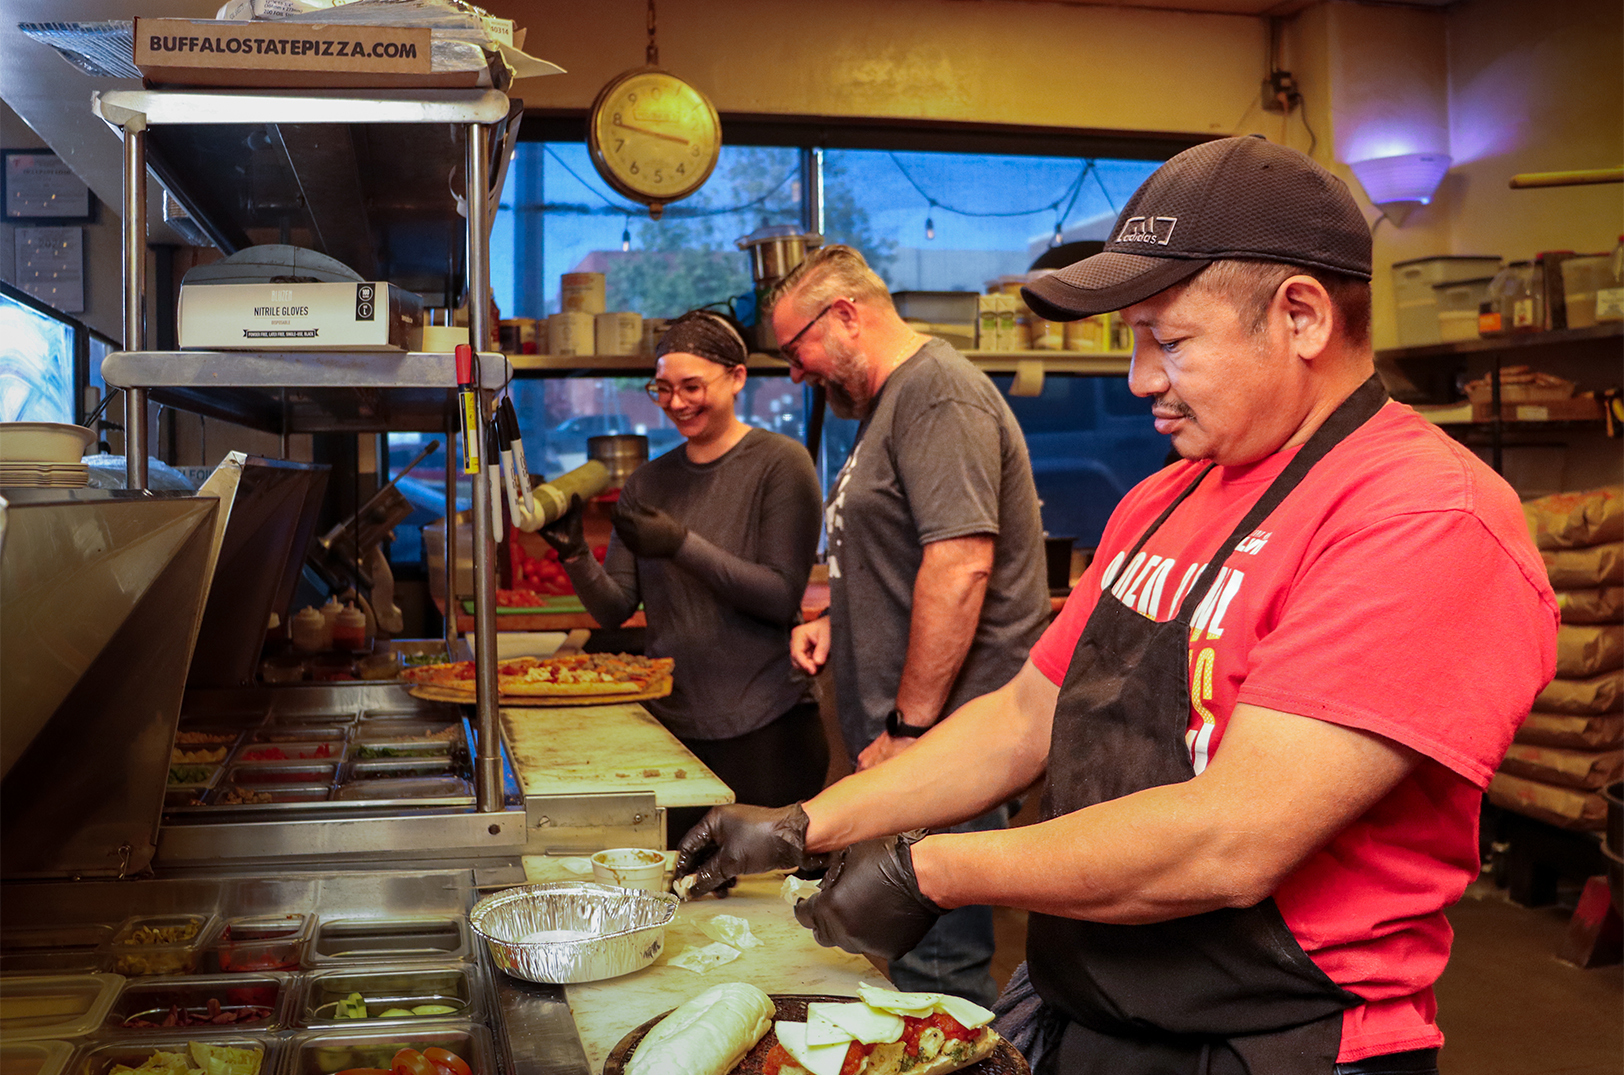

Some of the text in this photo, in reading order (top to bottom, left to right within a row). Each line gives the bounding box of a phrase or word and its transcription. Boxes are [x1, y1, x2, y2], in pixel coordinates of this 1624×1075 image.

[150, 36, 417, 58] BUFFALOSTATEPIZZA.COM
[628, 93, 637, 106] 9
[613, 112, 622, 126] 8
[615, 139, 624, 153] 7
[630, 161, 640, 175] 6
[676, 162, 685, 176] 4
[654, 170, 663, 183] 5
[1123, 231, 1157, 244] adidas
[254, 306, 309, 317] NITRILE GLOVES
